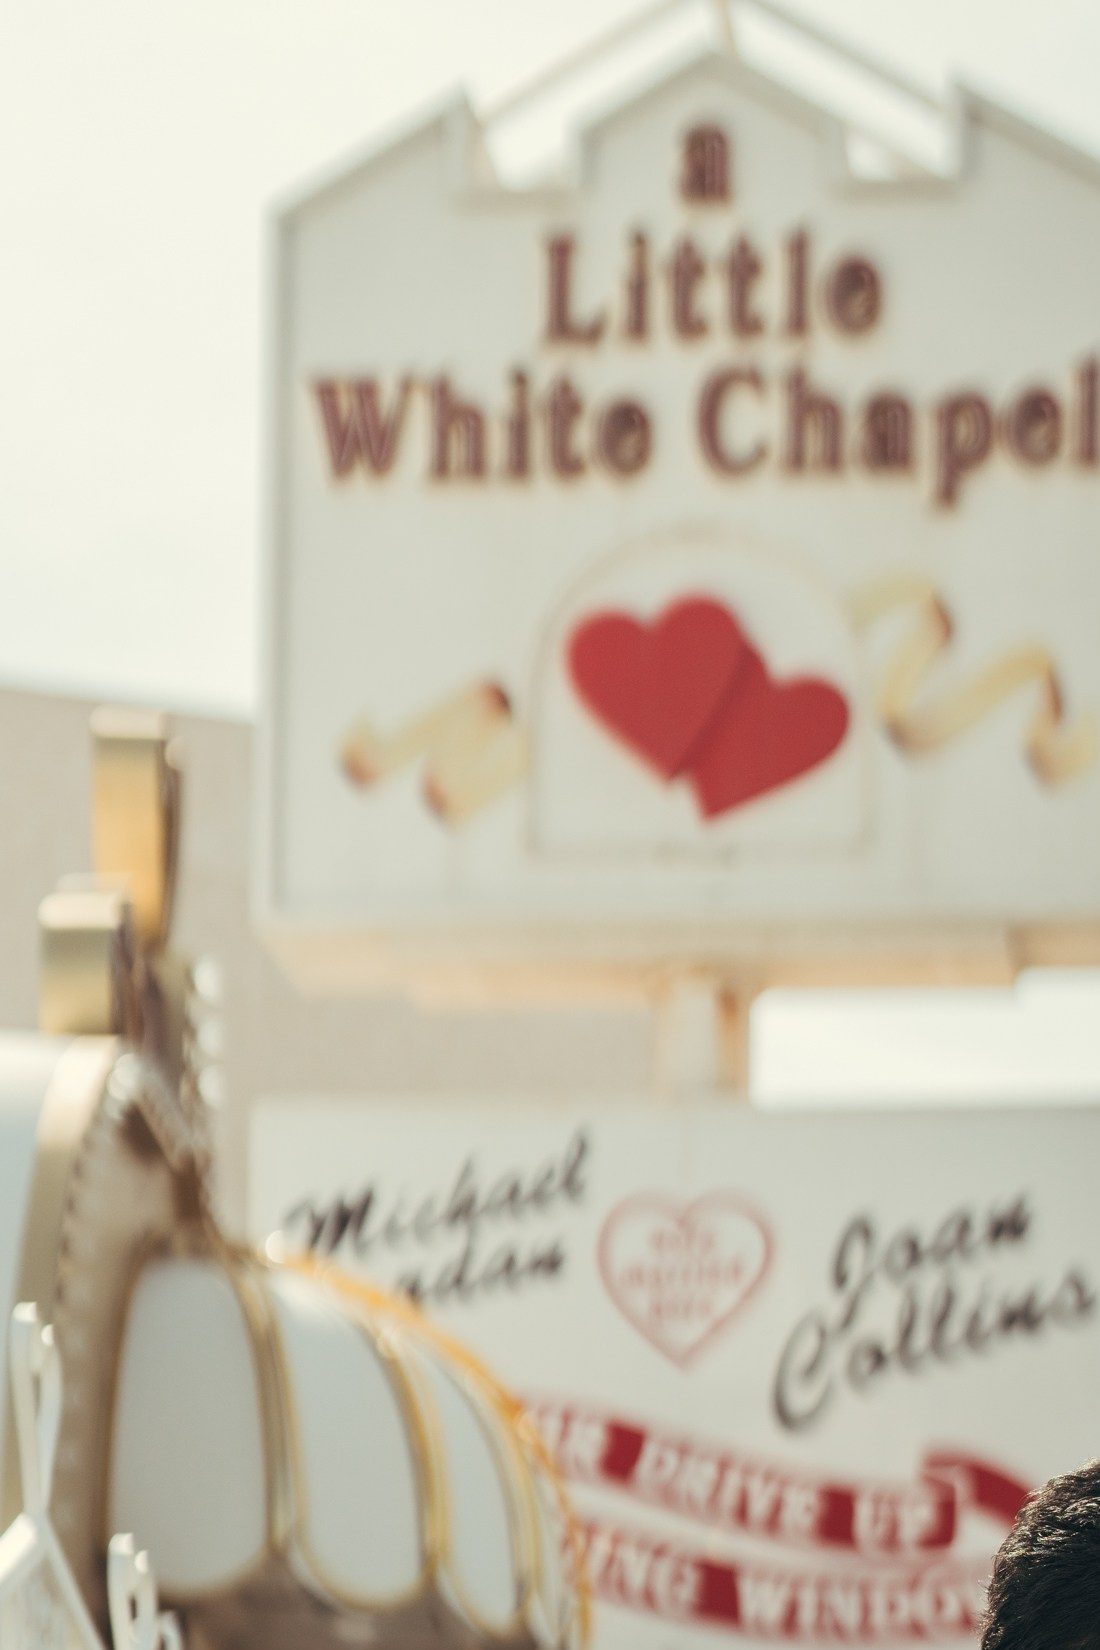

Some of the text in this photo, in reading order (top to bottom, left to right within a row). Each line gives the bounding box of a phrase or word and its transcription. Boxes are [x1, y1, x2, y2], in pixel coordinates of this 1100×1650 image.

[546, 228, 883, 344] Little
[312, 368, 654, 484] White
[284, 1130, 590, 1256] Michael
[830, 1190, 1034, 1334] Joan
[772, 1262, 1100, 1436] Collins
[630, 1436, 818, 1546] DRIVE
[854, 1484, 940, 1556] UP
[738, 1564, 990, 1644] WINDO
